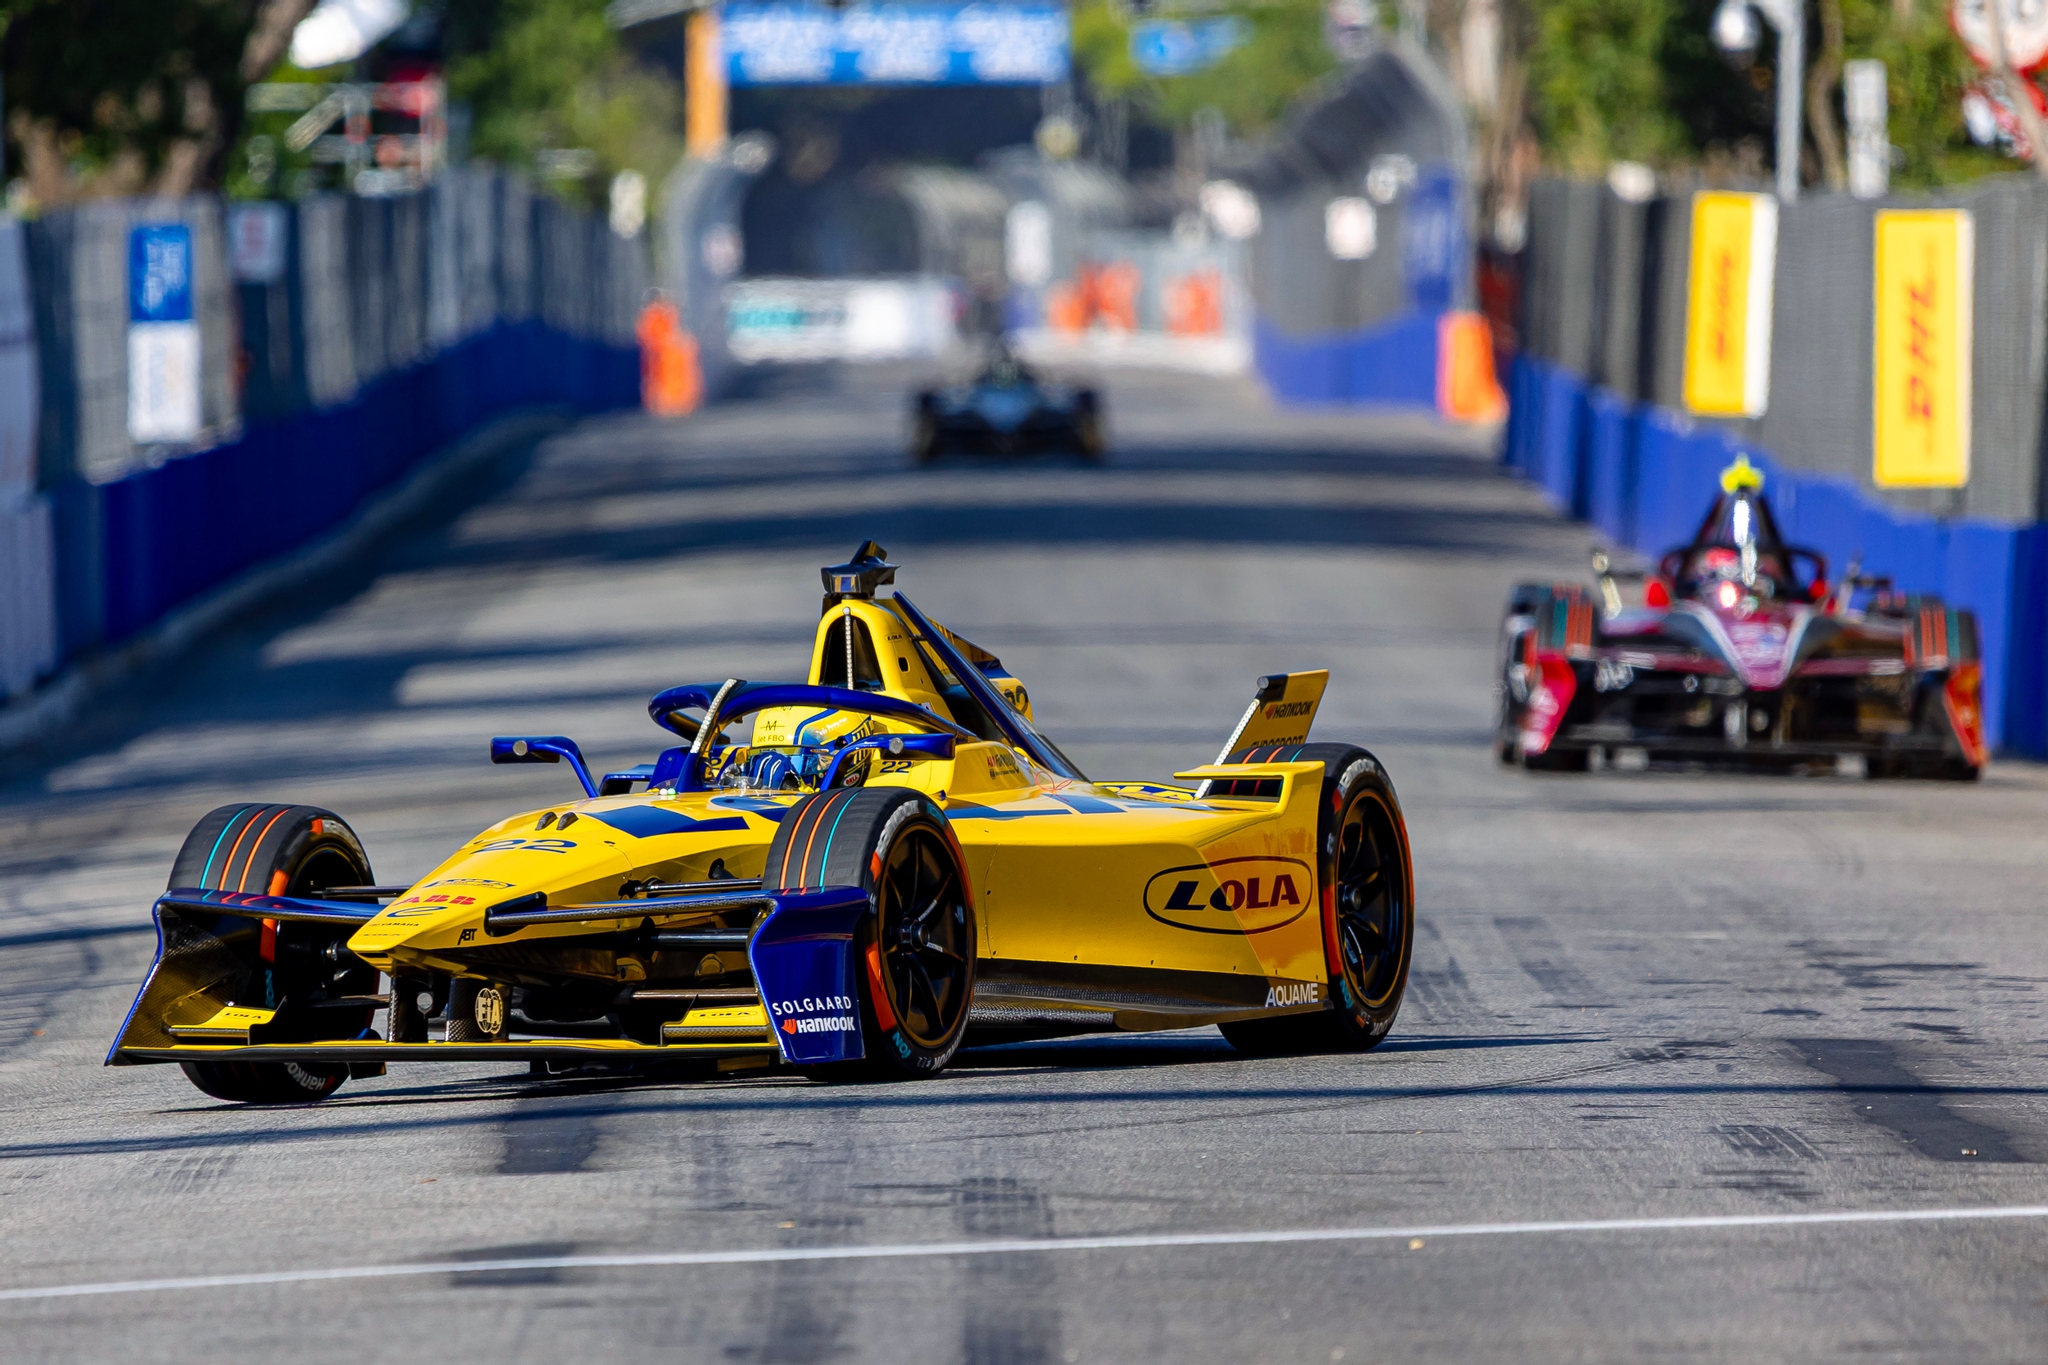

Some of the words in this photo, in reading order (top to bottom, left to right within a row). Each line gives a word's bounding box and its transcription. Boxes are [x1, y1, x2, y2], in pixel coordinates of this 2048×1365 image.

[879, 760, 912, 774] 22
[845, 774, 859, 785] BELL
[469, 839, 577, 855] 22
[392, 894, 477, 906] ABB
[1163, 874, 1300, 912] LOLA
[457, 928, 478, 945] ABT
[1265, 983, 1319, 1008] AQUAME
[772, 996, 852, 1016] SOLGAARD
